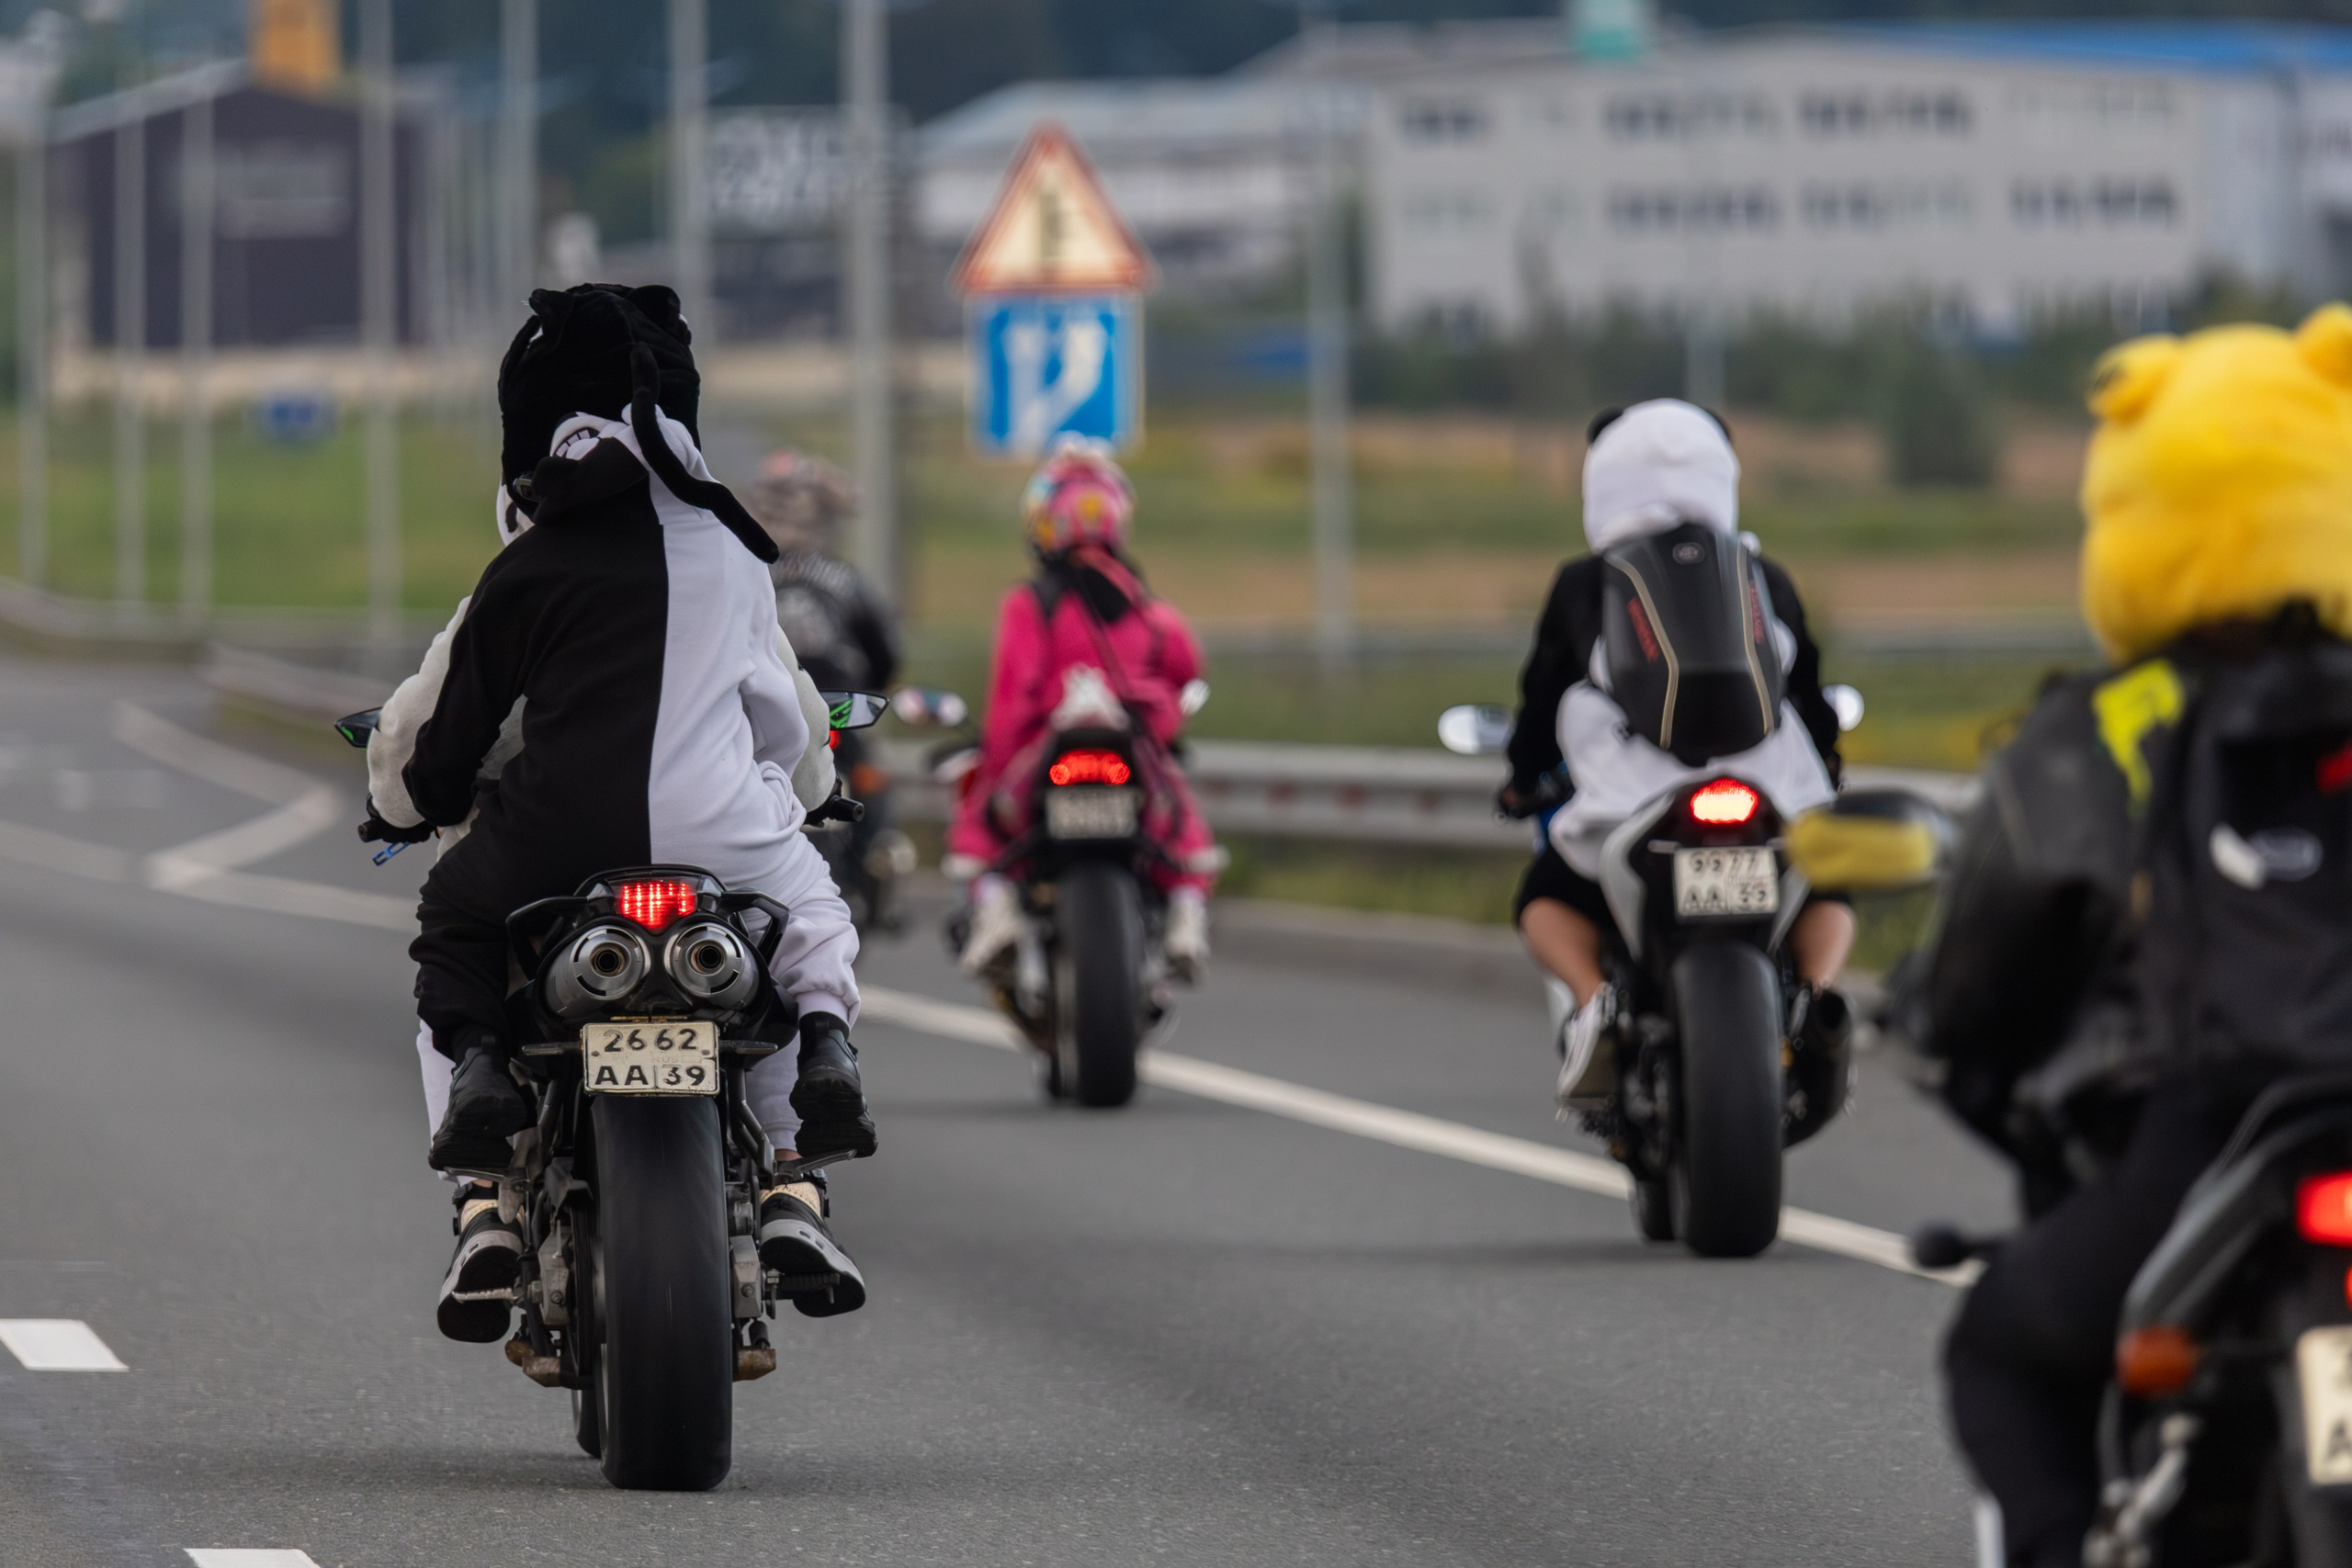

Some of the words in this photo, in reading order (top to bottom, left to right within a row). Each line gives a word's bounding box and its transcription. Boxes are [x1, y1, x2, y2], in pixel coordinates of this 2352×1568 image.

[603, 1028, 698, 1053] 2662
[594, 1065, 649, 1086] AA
[662, 1065, 706, 1086] 39
